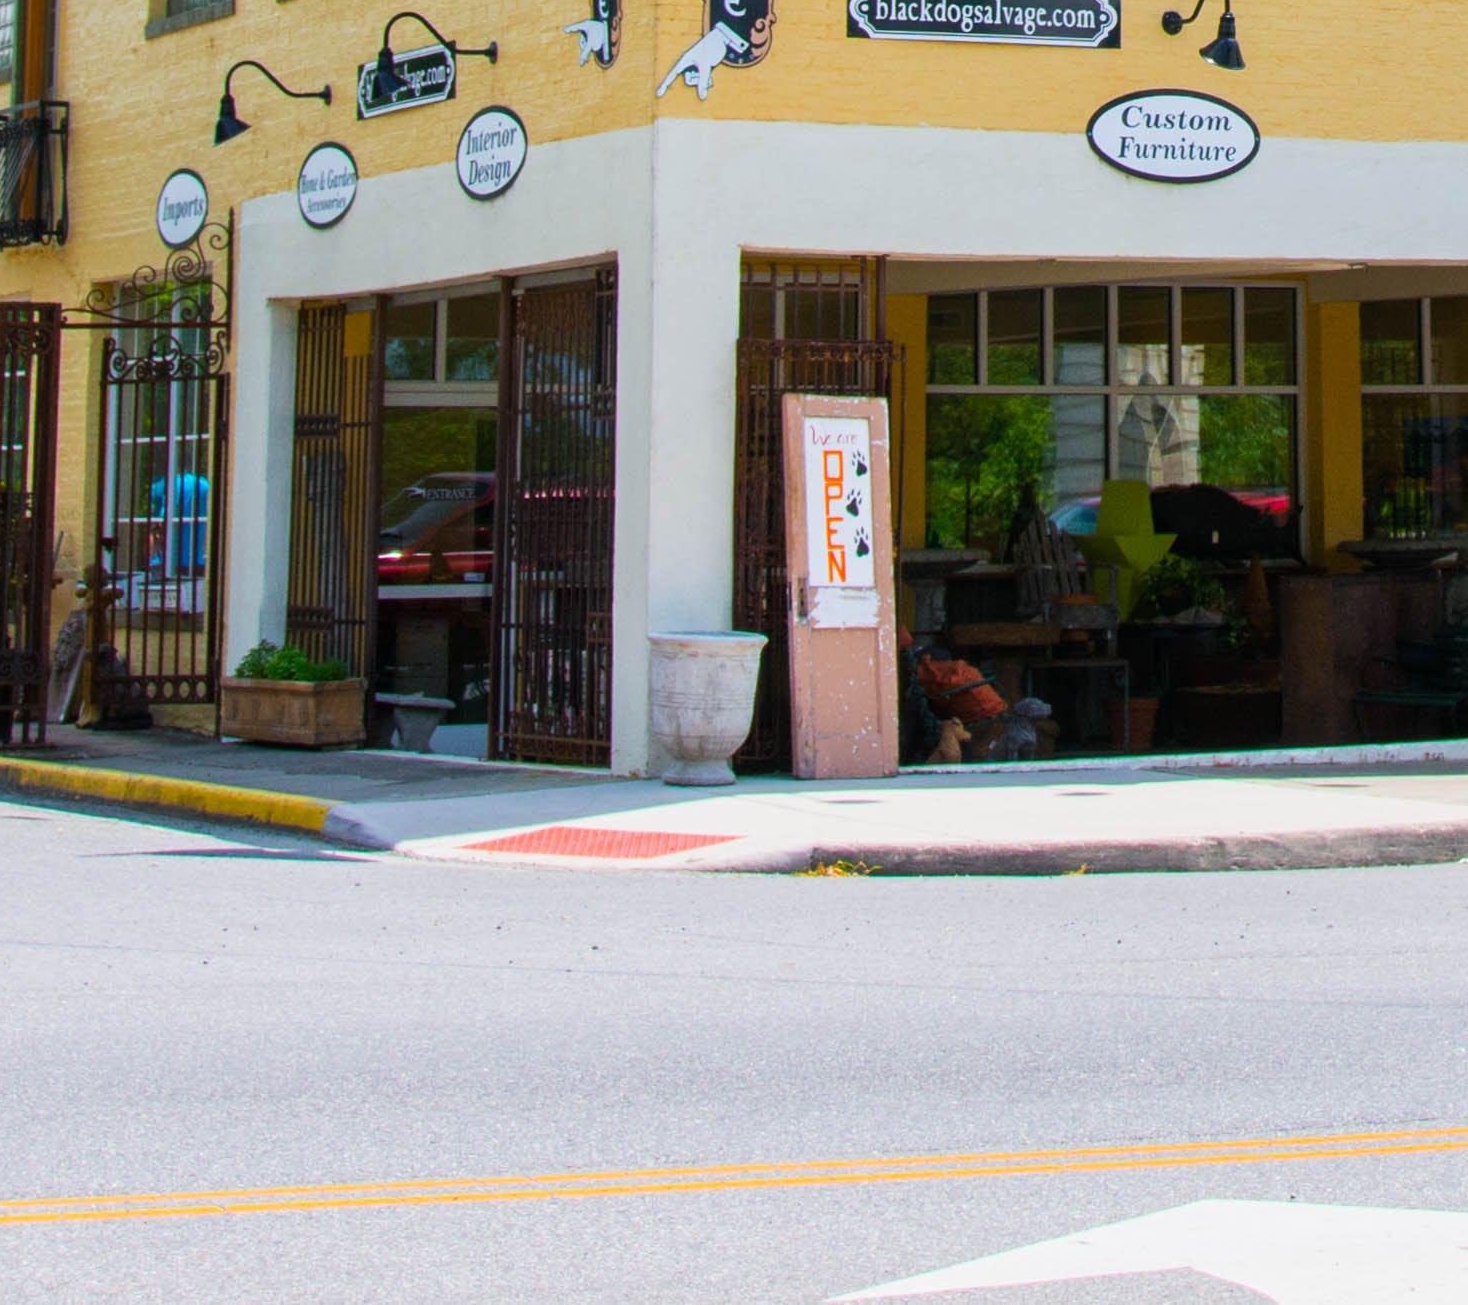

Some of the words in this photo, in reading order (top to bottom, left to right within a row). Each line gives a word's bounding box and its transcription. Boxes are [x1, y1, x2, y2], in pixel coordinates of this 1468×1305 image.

[1120, 104, 1233, 132] Custom
[466, 121, 518, 155] Interior
[1117, 134, 1238, 164] Furniture
[468, 153, 512, 187] Design
[162, 196, 204, 227] Imports
[426, 487, 476, 500] ENTRANCE
[823, 450, 847, 583] OPEN
